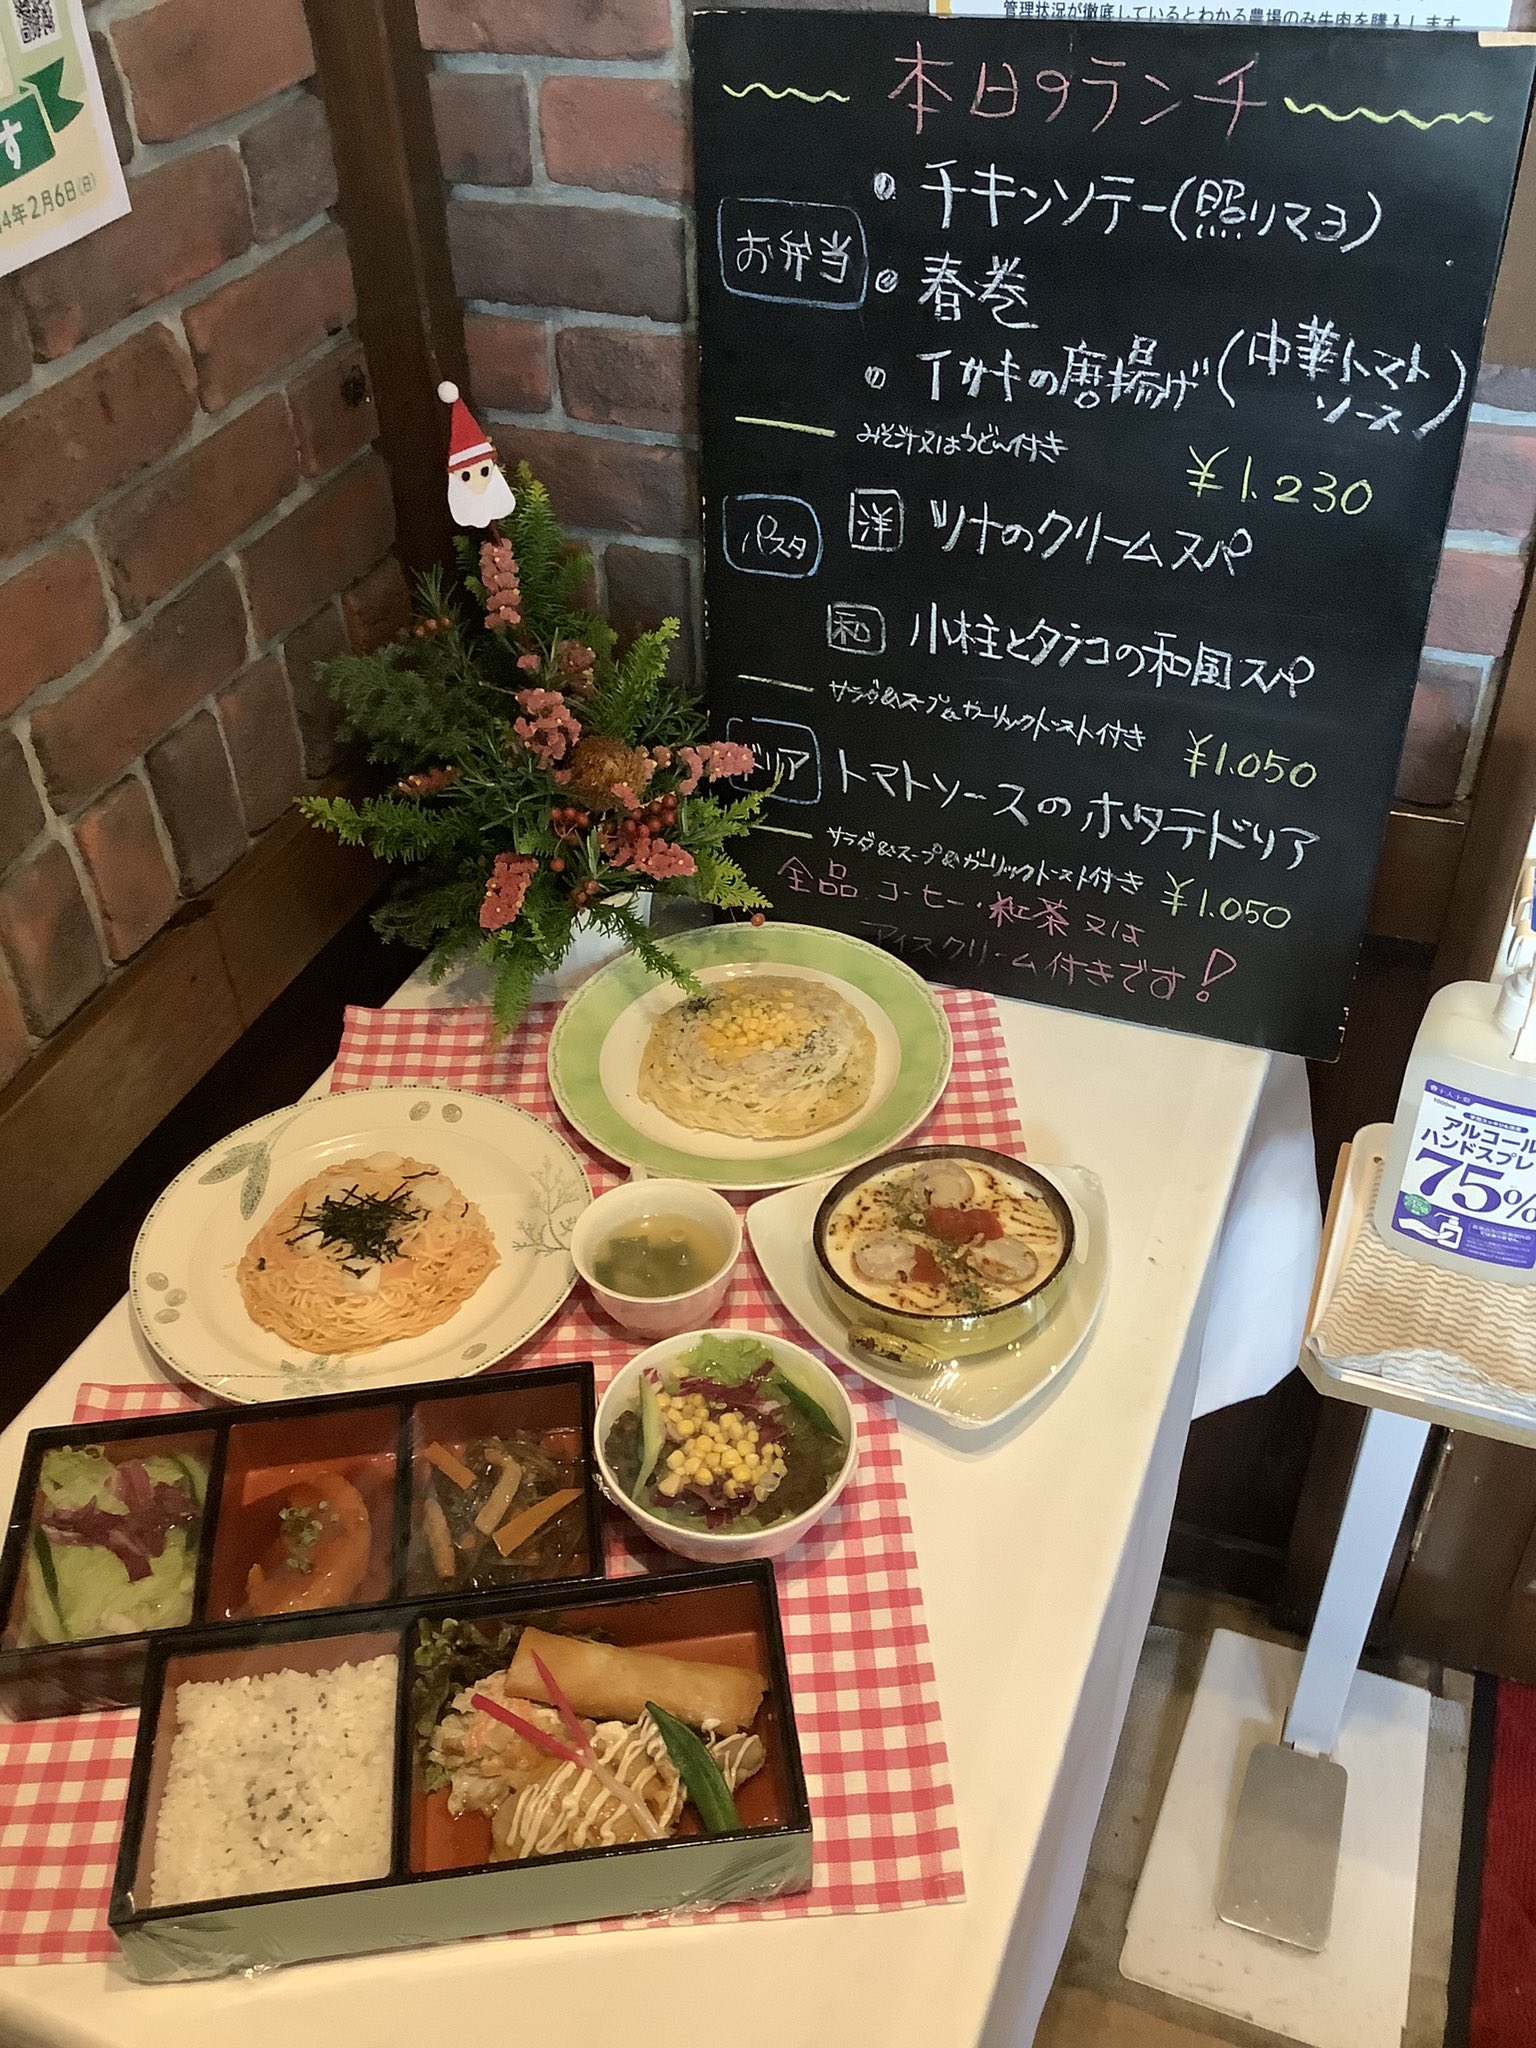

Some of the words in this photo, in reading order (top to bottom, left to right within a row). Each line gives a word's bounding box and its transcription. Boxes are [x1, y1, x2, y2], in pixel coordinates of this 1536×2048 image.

[886, 40, 1268, 136] 本日のランチ
[0, 171, 97, 234] 4年2月6日(日)
[736, 229, 853, 284] お弁当
[917, 253, 1039, 330] 春巻
[741, 514, 806, 560] パスタ
[857, 504, 895, 547] 洋
